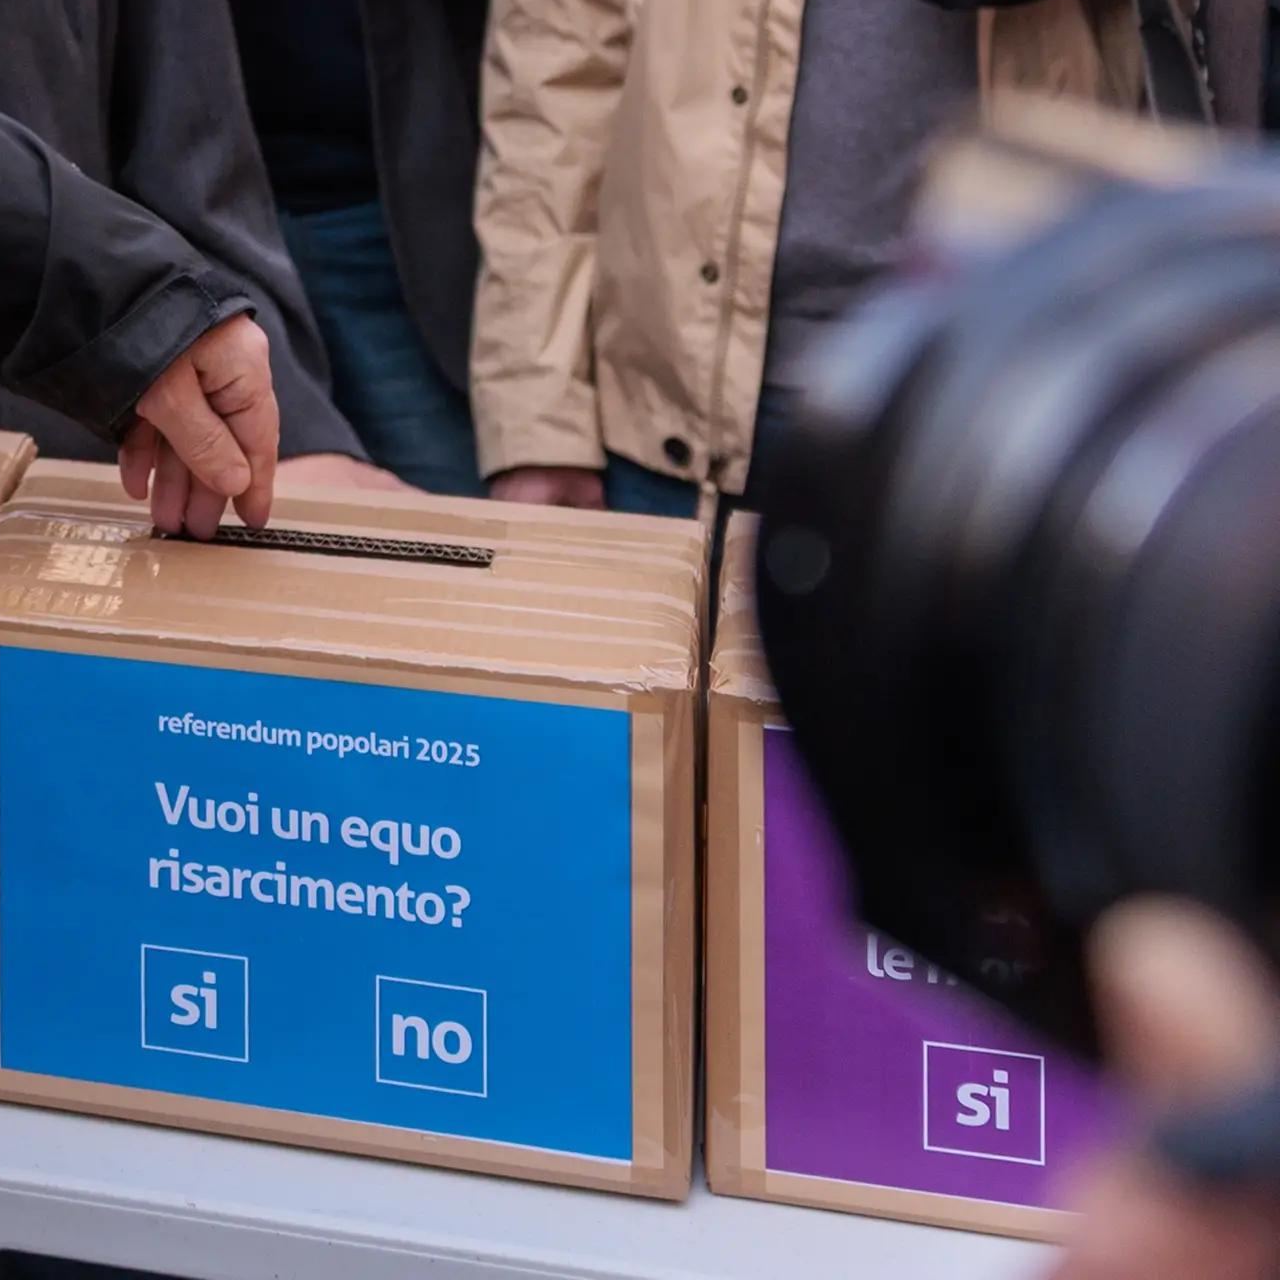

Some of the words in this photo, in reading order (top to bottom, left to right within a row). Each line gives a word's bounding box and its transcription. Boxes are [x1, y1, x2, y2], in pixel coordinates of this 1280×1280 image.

[158, 711, 302, 747] referendum
[306, 730, 410, 759] popolari
[415, 737, 482, 768] 2025
[154, 781, 260, 836] Vuoi
[271, 807, 330, 844] un
[340, 815, 462, 866] equo
[148, 848, 472, 929] risarcimento?
[866, 932, 915, 981] le
[169, 970, 218, 1030] si
[391, 1013, 473, 1065] no
[955, 1069, 1012, 1131] si
